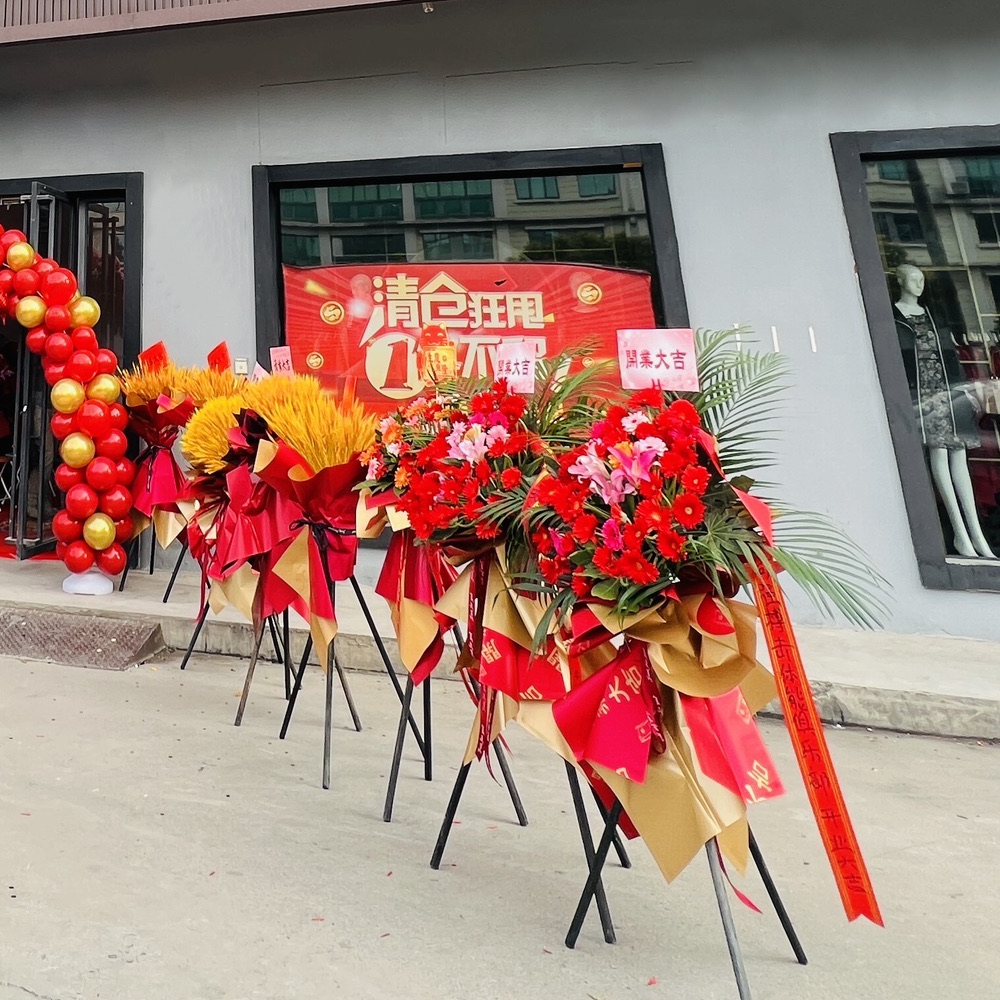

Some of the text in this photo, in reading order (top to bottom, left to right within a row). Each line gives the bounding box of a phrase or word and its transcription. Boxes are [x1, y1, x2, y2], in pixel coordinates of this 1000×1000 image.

[359, 271, 546, 347] 清仓狂甩
[625, 348, 687, 370] 開業大吉
